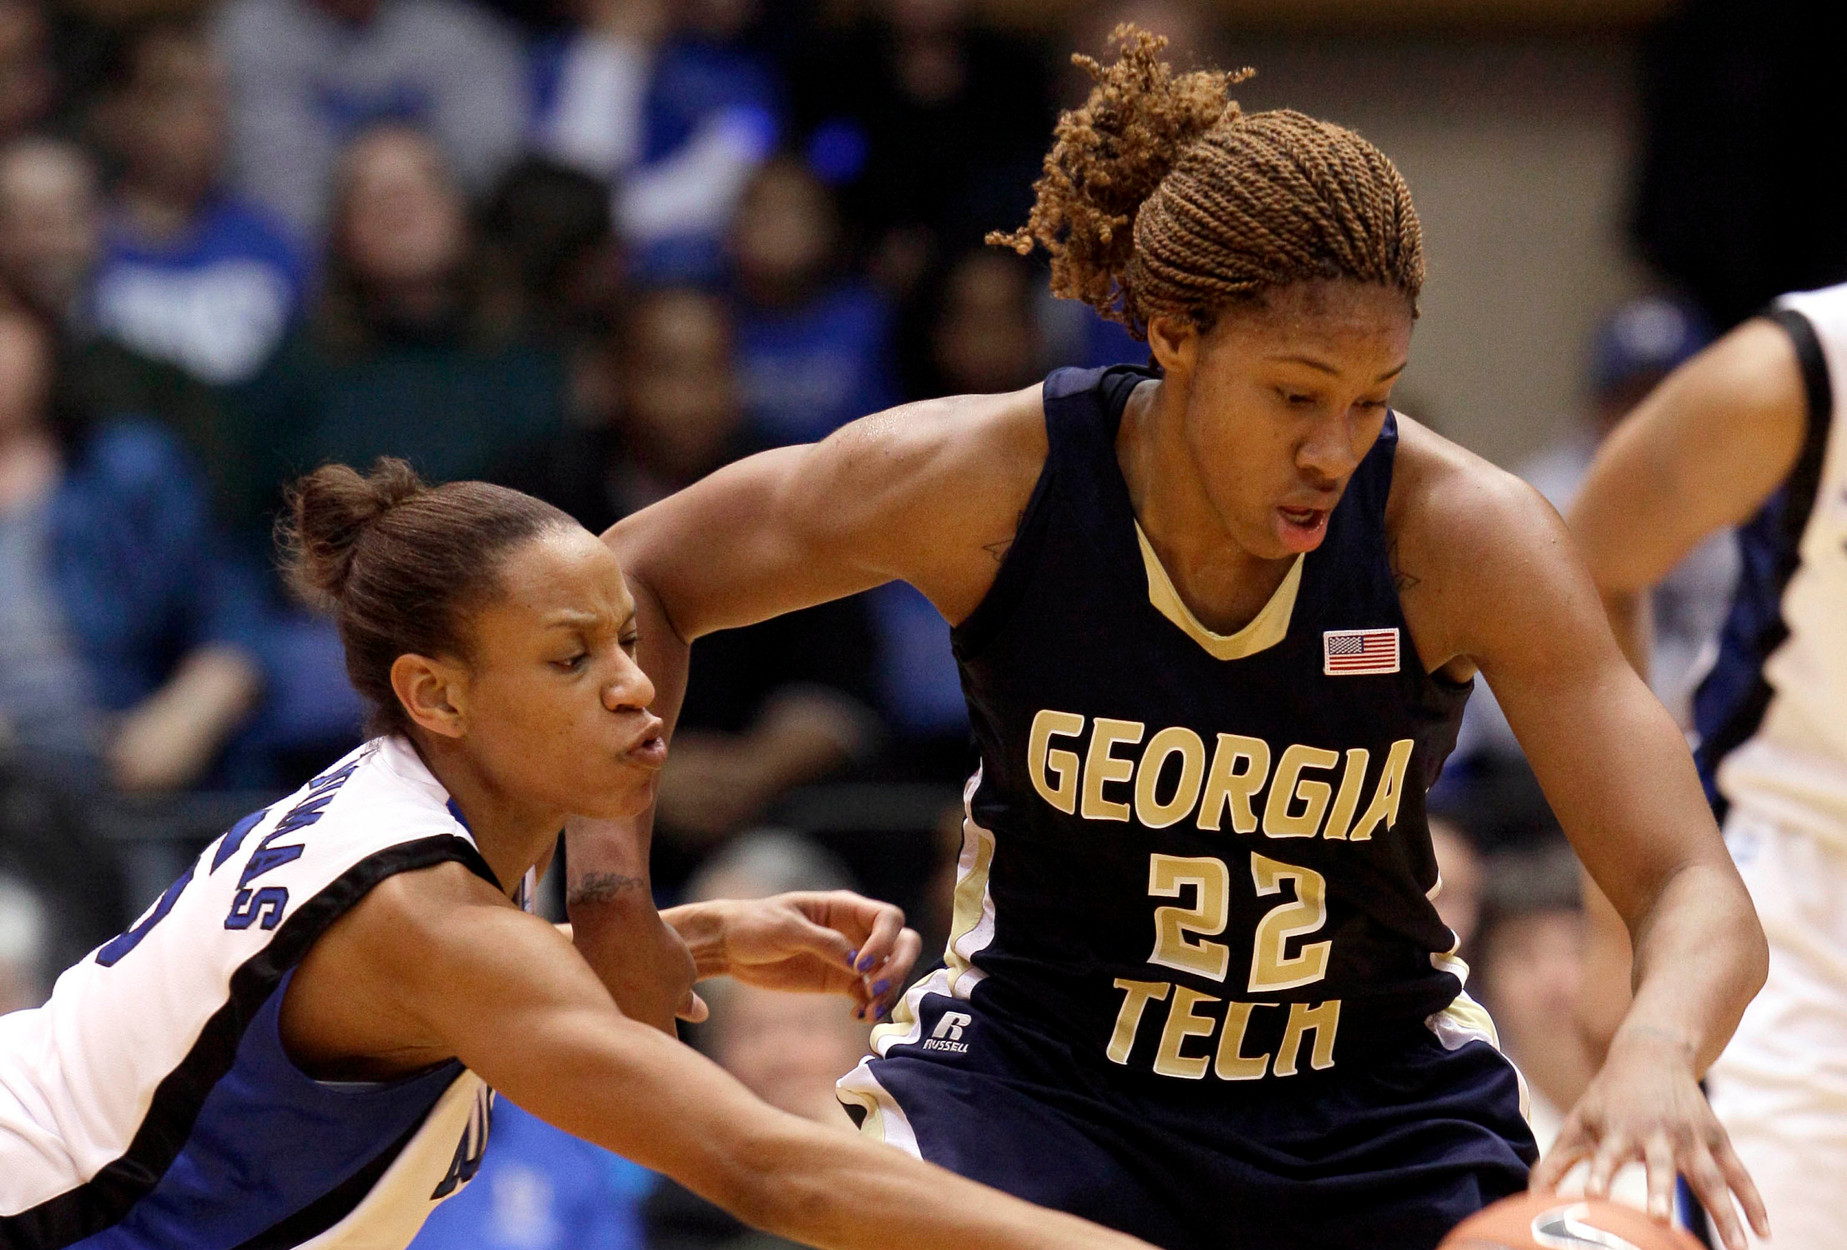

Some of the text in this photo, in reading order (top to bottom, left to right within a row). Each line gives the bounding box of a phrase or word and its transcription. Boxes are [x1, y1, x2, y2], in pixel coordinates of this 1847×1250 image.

[1027, 708, 1415, 841] GEORGIA
[1146, 851, 1333, 993] 22
[922, 1038, 970, 1053] RUSSELL
[1105, 977, 1342, 1081] TECH
